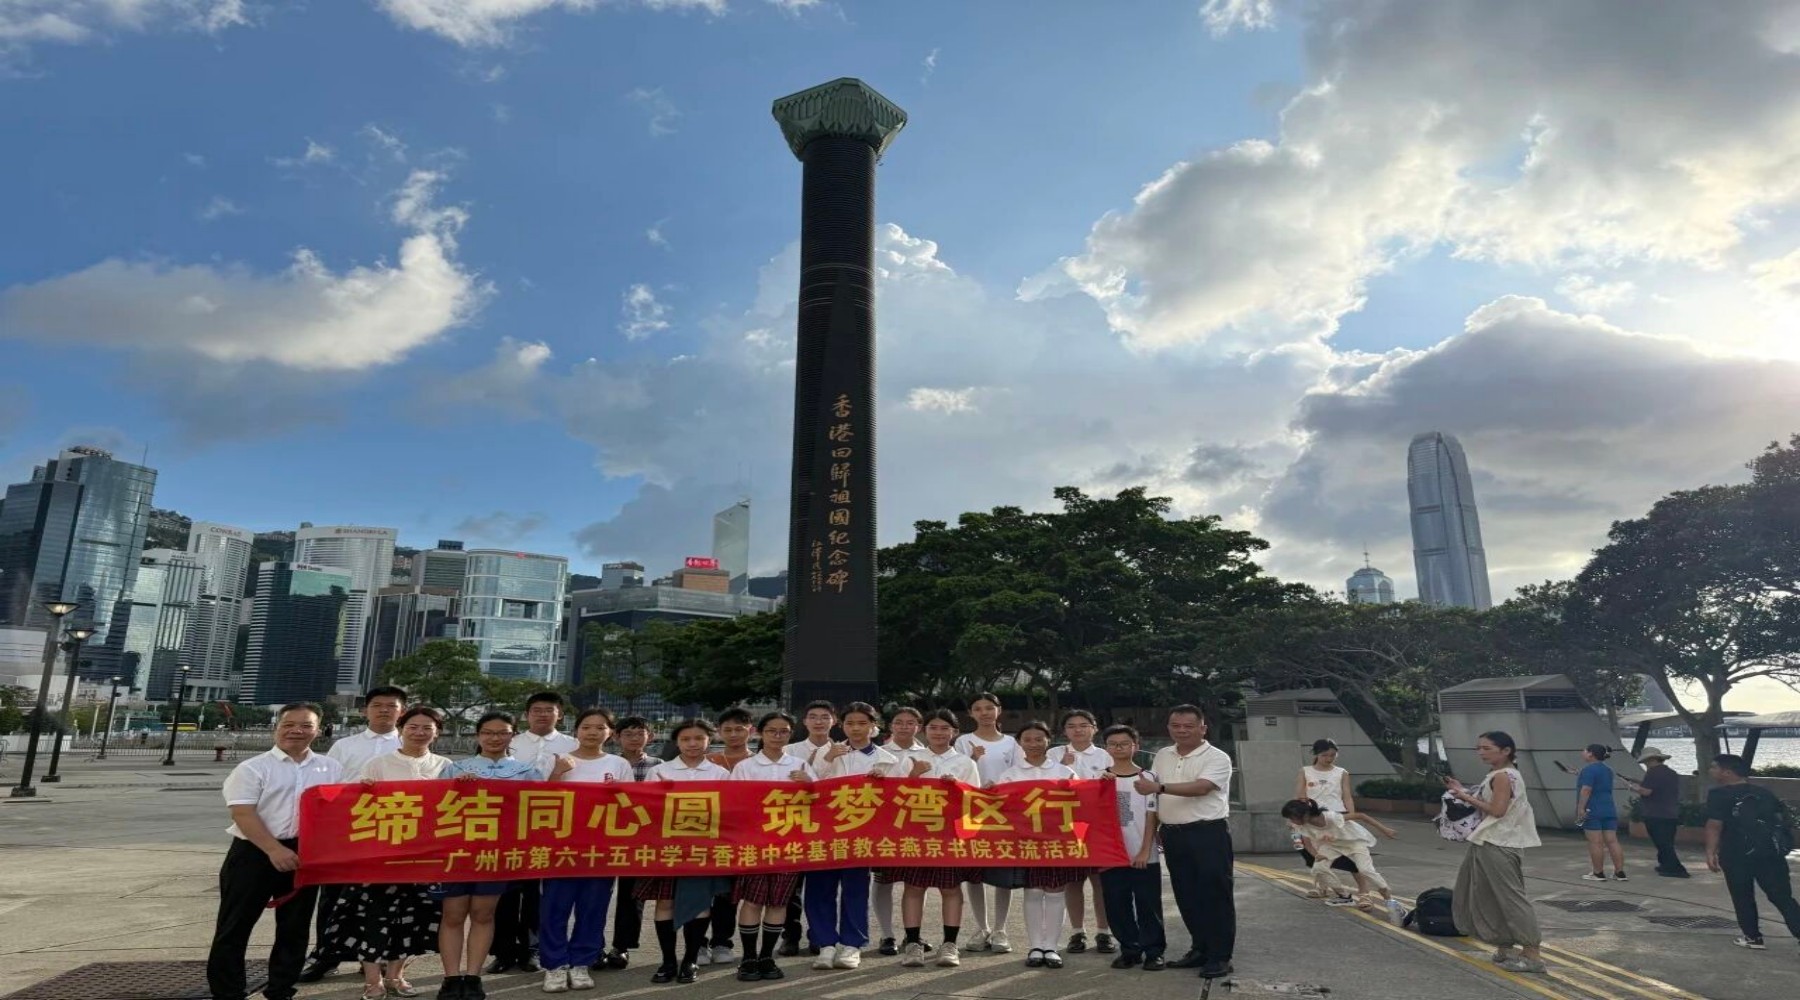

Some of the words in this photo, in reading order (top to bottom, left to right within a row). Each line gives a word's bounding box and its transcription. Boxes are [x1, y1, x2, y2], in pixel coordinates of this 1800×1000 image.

[349, 789, 721, 845] 缔结同心圆
[762, 784, 1081, 836] 筑梦湾区行
